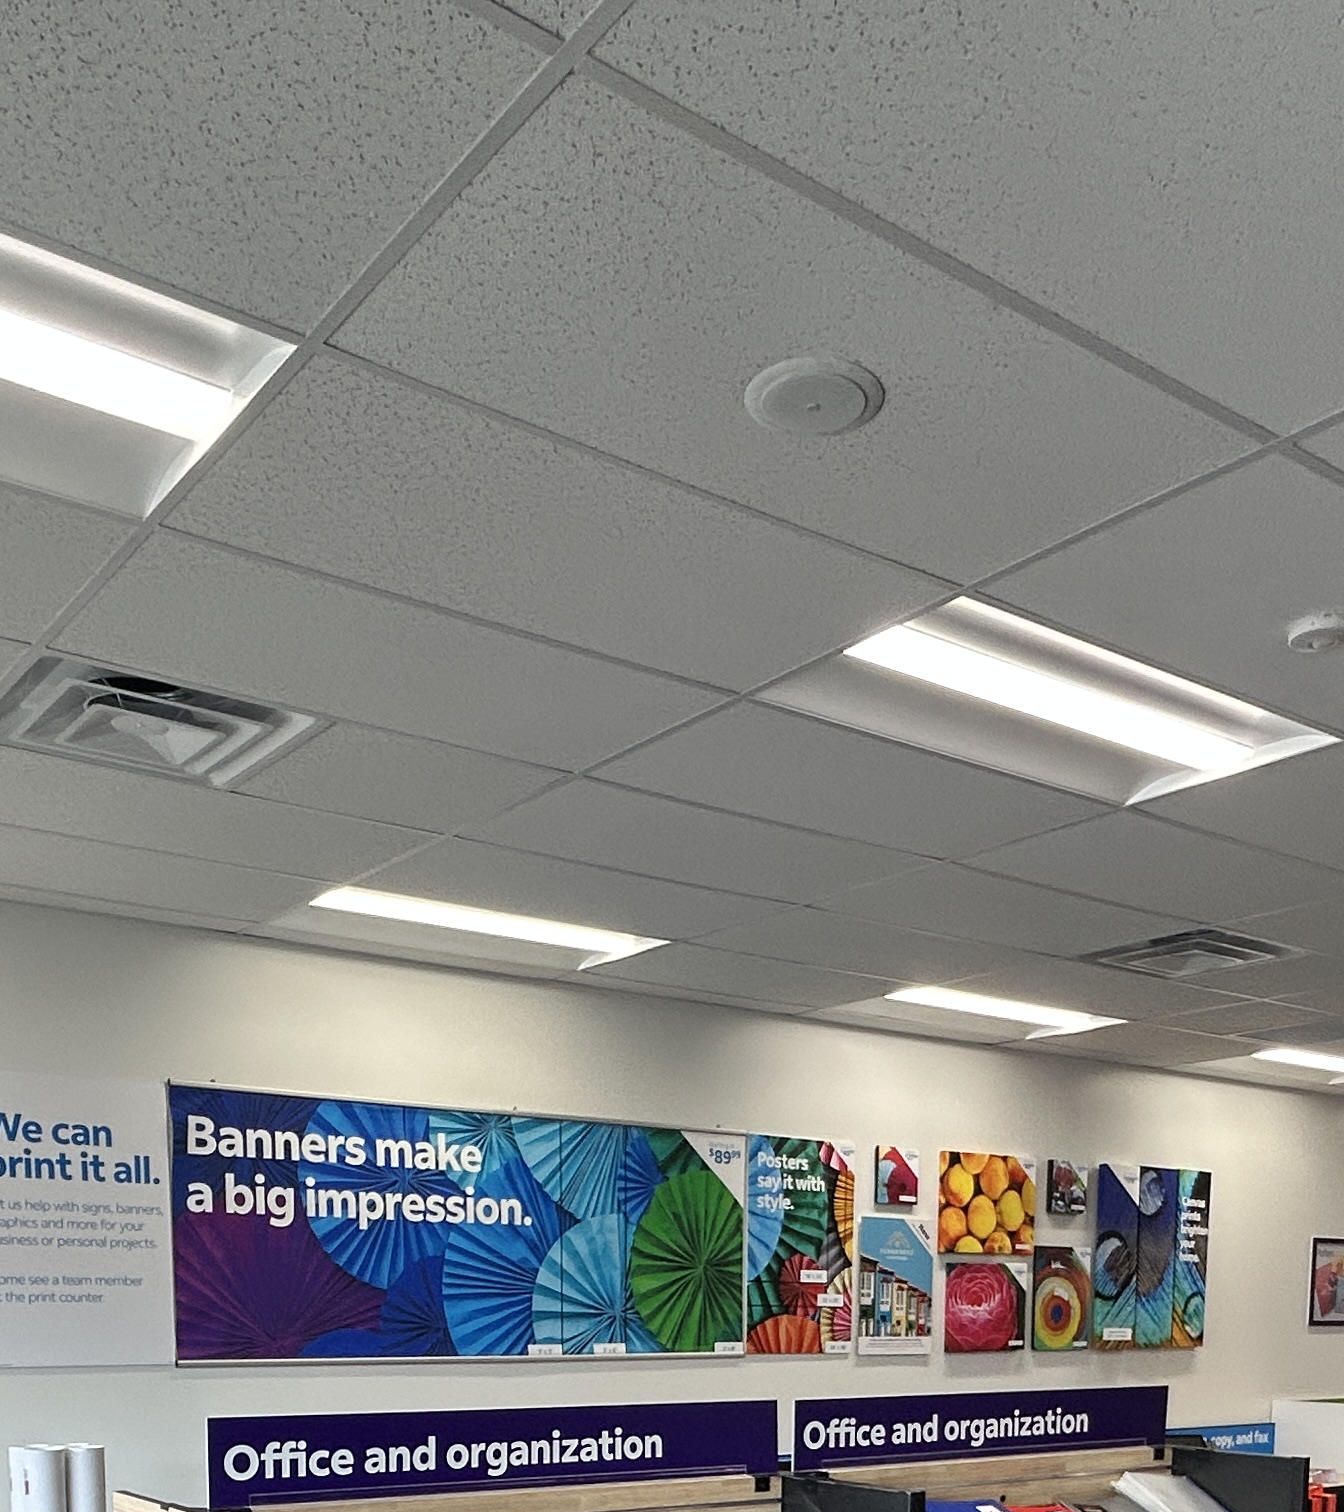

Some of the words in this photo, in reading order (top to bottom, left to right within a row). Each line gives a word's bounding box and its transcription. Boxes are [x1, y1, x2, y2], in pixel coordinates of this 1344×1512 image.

[51, 1122, 113, 1148] can
[185, 1114, 367, 1167] Banners
[375, 1131, 484, 1175] make
[80, 1151, 106, 1183] it
[113, 1155, 161, 1185] all.
[757, 1151, 810, 1172] Posters
[757, 1174, 782, 1193] say
[782, 1173, 794, 1190] it
[795, 1175, 826, 1193] with
[8, 1201, 23, 1211] us
[24, 1199, 52, 1213] help
[53, 1200, 80, 1213] with
[81, 1202, 115, 1216] signs,
[115, 1202, 164, 1217] banners,
[185, 1183, 215, 1216] a
[224, 1174, 296, 1229] big
[304, 1177, 533, 1230] impression.
[756, 1194, 795, 1213] style.
[40, 1217, 64, 1229] and
[66, 1219, 99, 1230] more
[100, 1218, 116, 1231] for
[119, 1221, 145, 1234] your
[41, 1236, 54, 1247] or
[57, 1236, 107, 1249] personal
[28, 1275, 50, 1286] see
[51, 1276, 59, 1286] a
[62, 1275, 93, 1286] team
[94, 1275, 144, 1287] member
[5, 1290, 26, 1303] the
[28, 1291, 56, 1305] print
[802, 1419, 886, 1451] Office
[891, 1414, 939, 1445] and
[943, 1407, 1090, 1447] organization
[1236, 1431, 1253, 1444] and
[1254, 1430, 1270, 1444] fax
[222, 1437, 355, 1482] Office
[364, 1435, 437, 1474] and
[445, 1426, 664, 1477] organization
